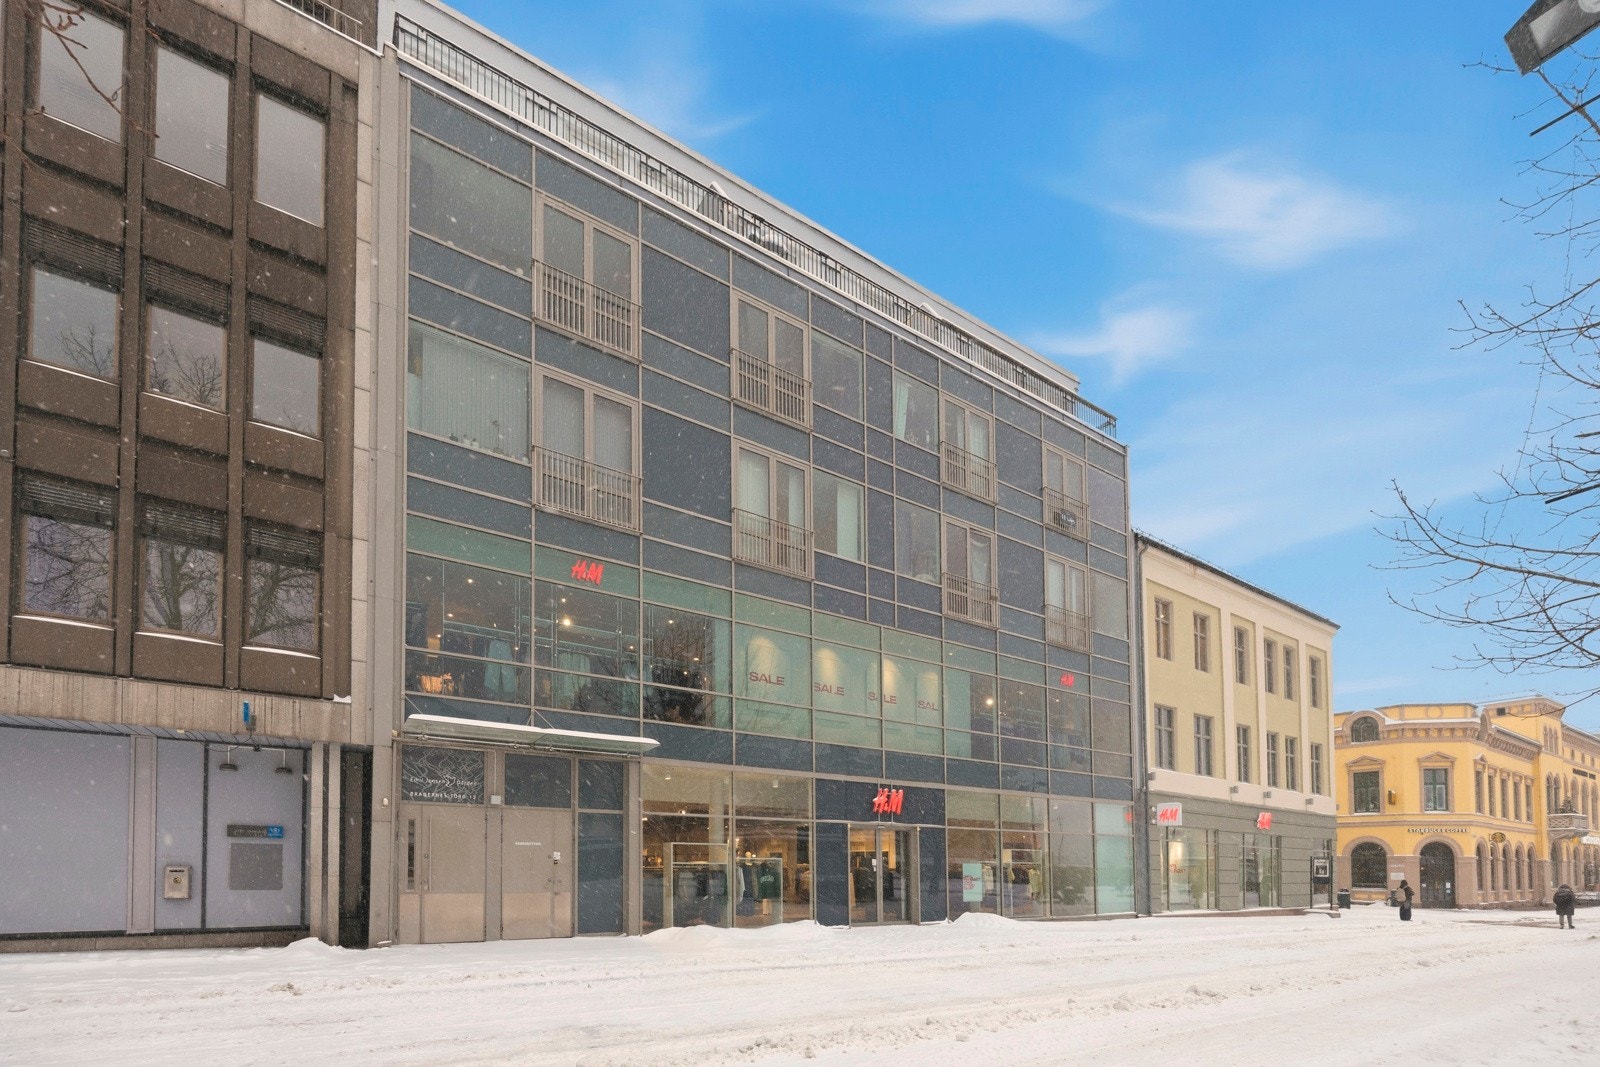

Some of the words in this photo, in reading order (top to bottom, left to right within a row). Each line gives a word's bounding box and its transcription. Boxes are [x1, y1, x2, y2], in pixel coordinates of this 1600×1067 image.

[749, 671, 785, 686] SALE
[868, 692, 897, 705] SLE
[872, 787, 904, 815] H&M
[1158, 808, 1179, 822] H&M
